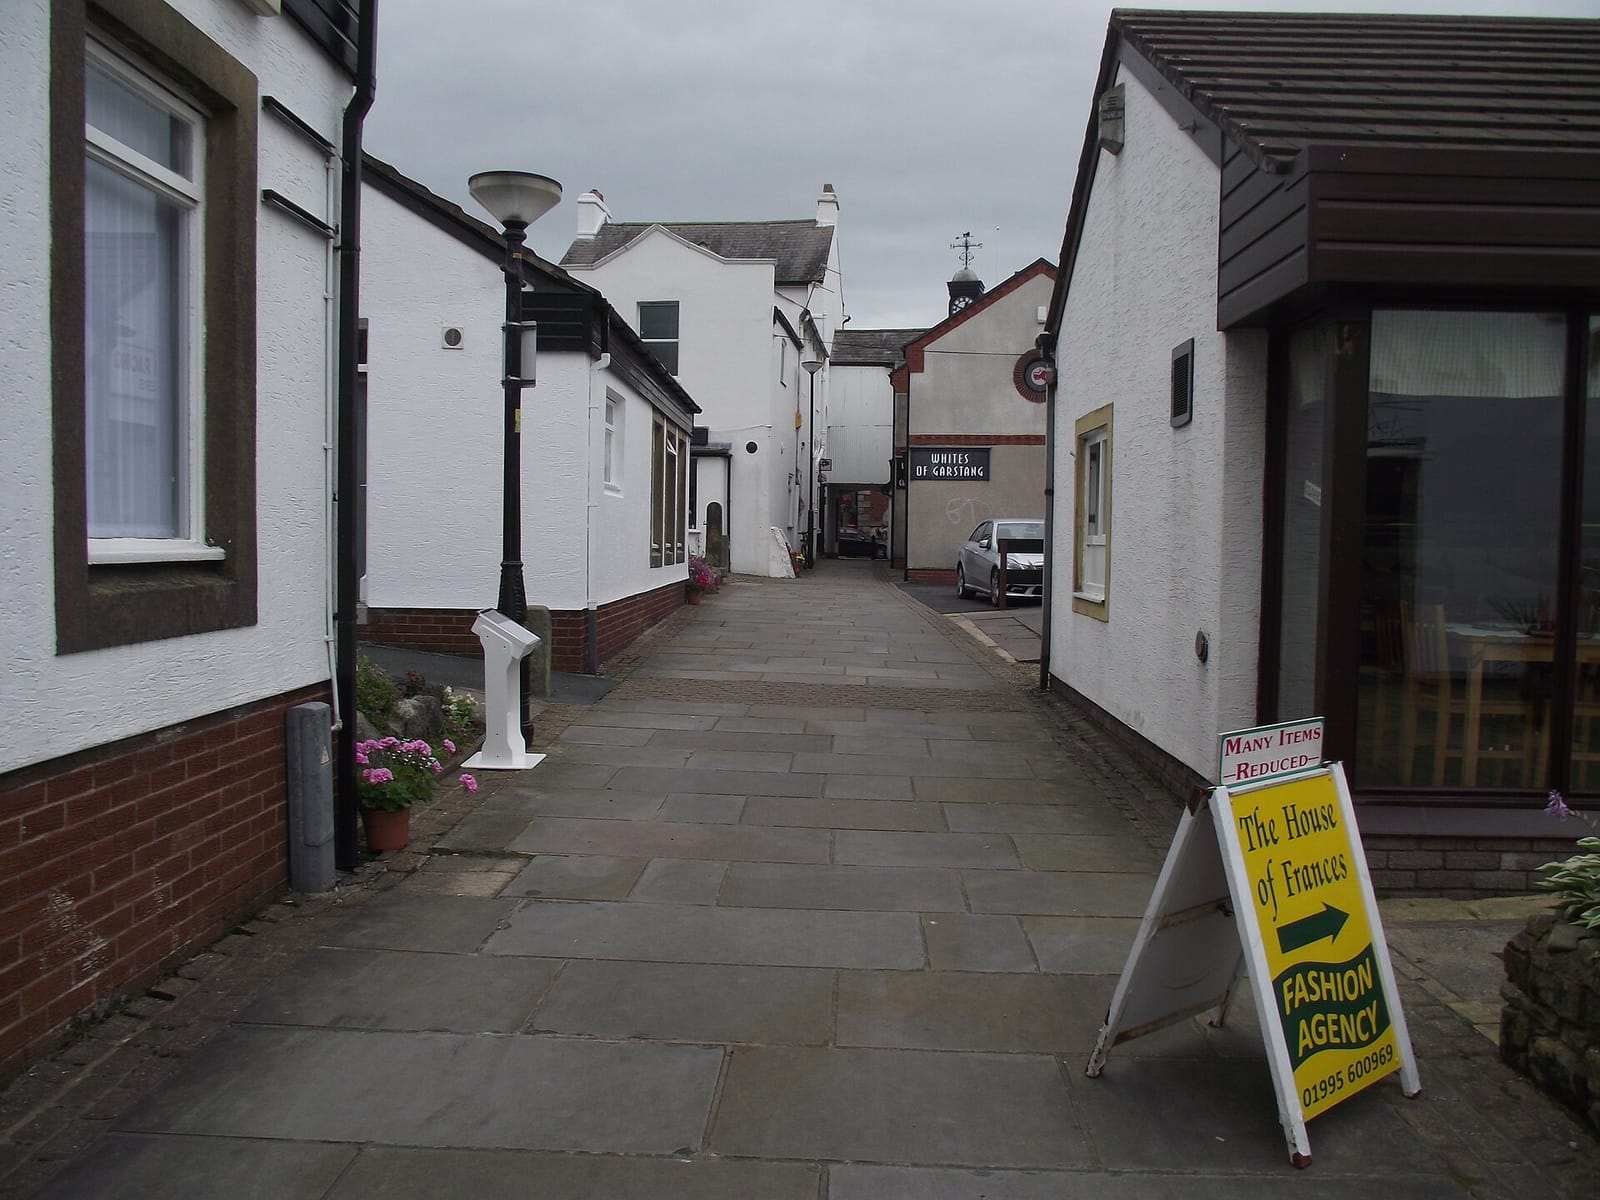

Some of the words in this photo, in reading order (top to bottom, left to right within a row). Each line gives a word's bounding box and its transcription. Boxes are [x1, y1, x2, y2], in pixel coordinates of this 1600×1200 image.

[916, 465, 928, 477] OF
[932, 465, 984, 477] GARSTANG
[931, 453, 969, 464] WHITES
[1224, 736, 1273, 757] MANY
[1279, 727, 1321, 746] ITEMS
[1236, 754, 1308, 780] REDUCED
[1239, 806, 1279, 852] The
[1281, 803, 1337, 841] House
[1257, 859, 1278, 922] of
[1281, 853, 1348, 898] Frances
[1282, 957, 1373, 1016] FASHION
[1298, 1000, 1378, 1058] AGENCY
[1302, 1071, 1344, 1108] 01995
[1347, 1043, 1394, 1083] 600969
